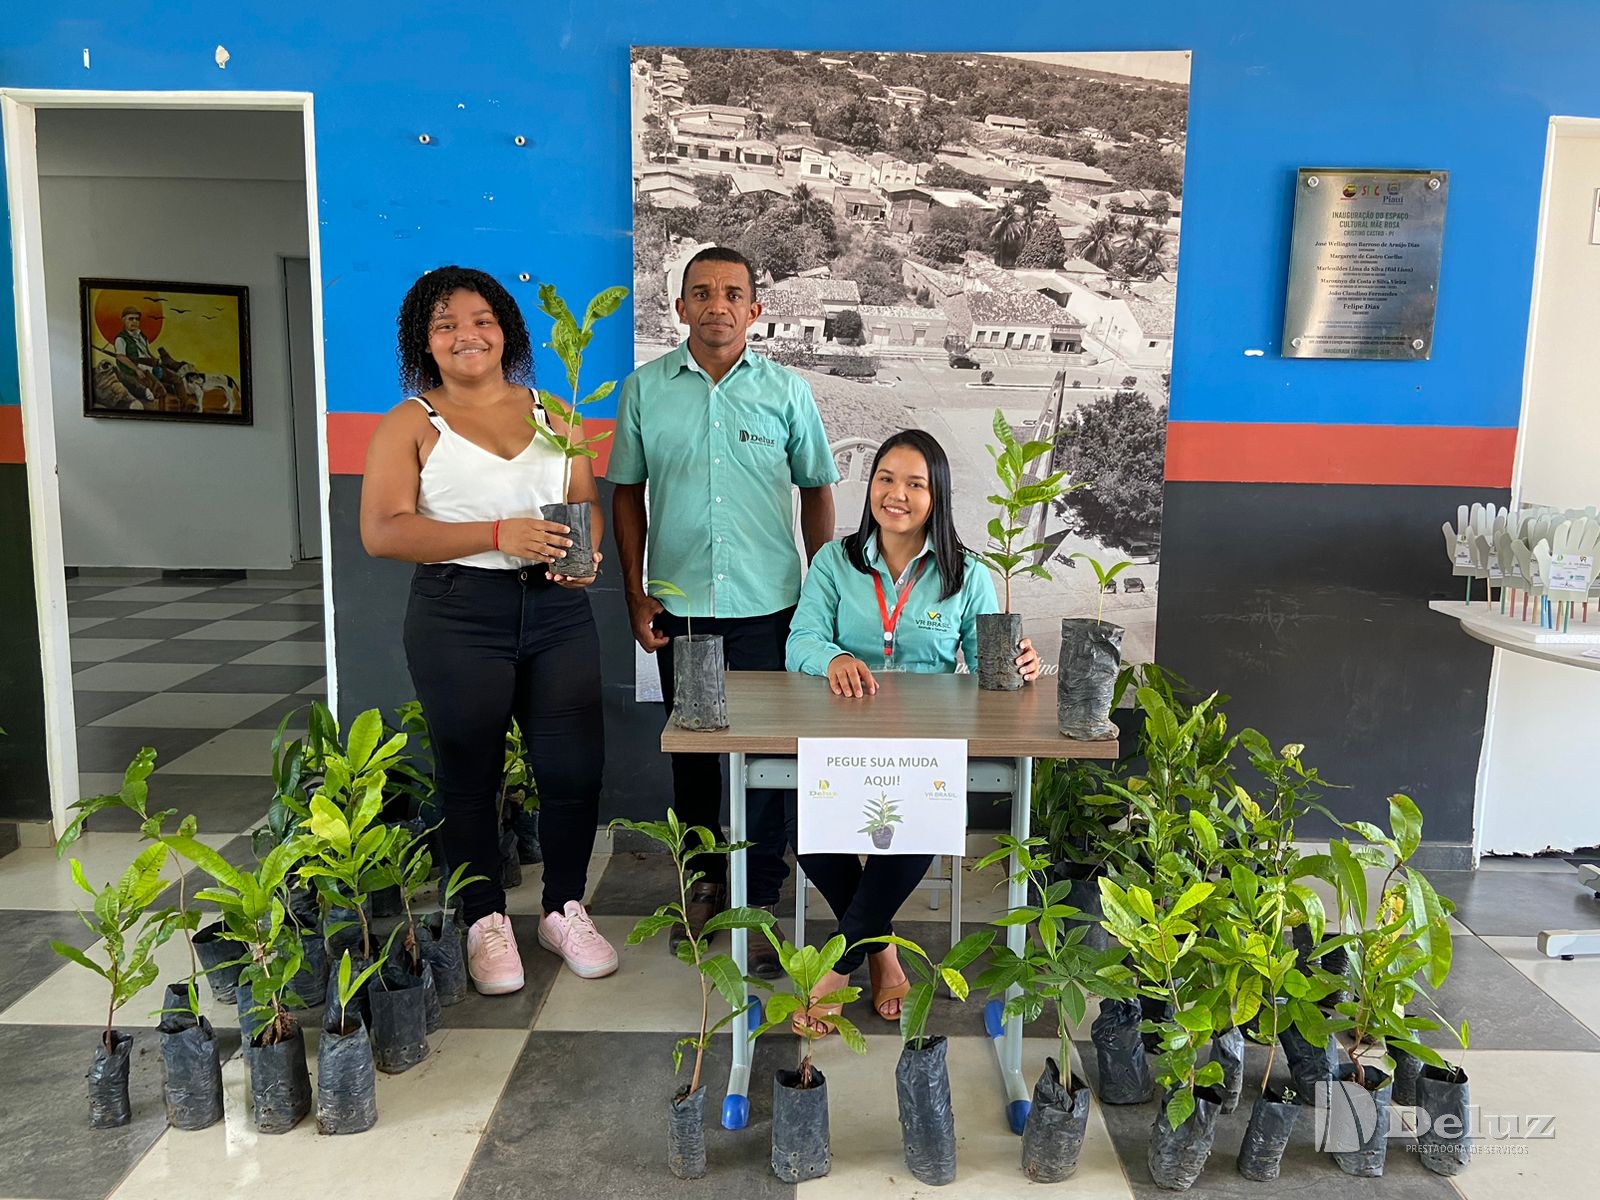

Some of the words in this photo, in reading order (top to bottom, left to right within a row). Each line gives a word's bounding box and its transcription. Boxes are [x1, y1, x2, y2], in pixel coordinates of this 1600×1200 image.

[1332, 210, 1374, 220] INAUGURAÇÃO
[1385, 212, 1408, 221] ESPAÇO
[1339, 220, 1368, 228] CULTURAL
[1370, 219, 1383, 228] MÃE
[1343, 303, 1364, 311] Felipe
[827, 757, 866, 768] PEGUE
[870, 757, 895, 768] SUA
[899, 757, 939, 768] MUDA
[863, 775, 901, 787] AQUI!
